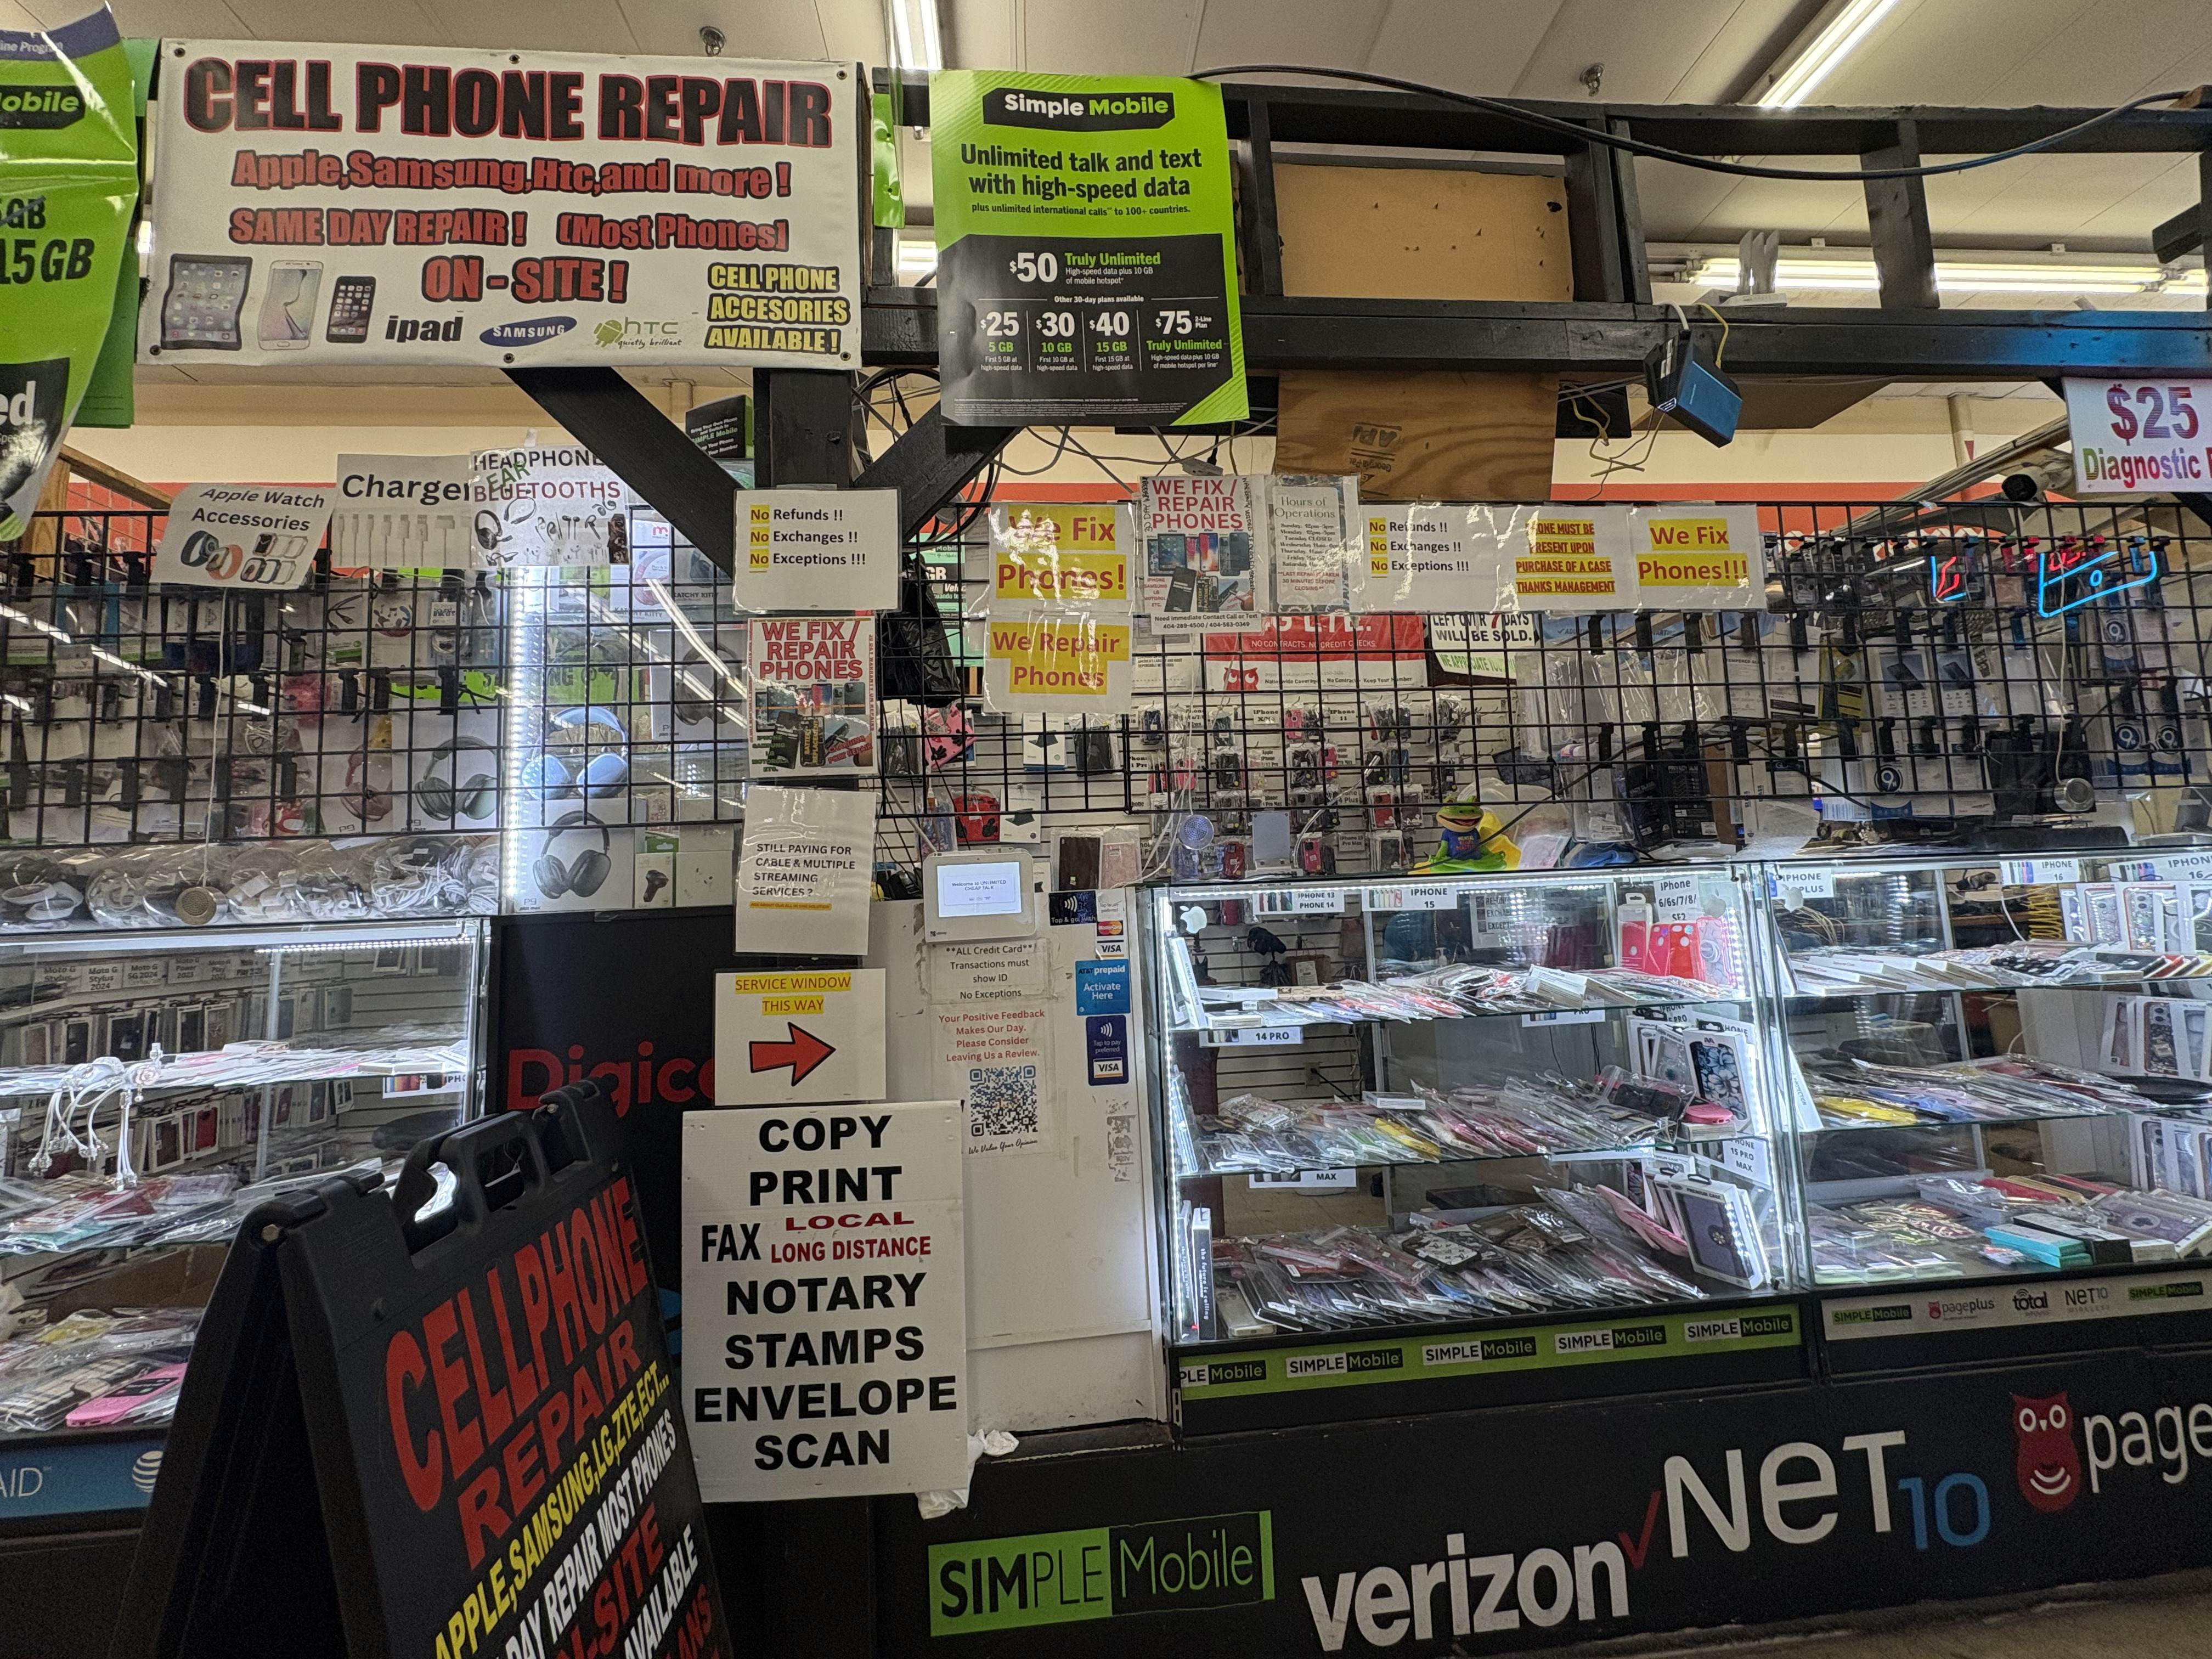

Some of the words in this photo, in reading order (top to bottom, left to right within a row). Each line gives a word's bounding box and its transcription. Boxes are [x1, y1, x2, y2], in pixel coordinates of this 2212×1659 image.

[184, 57, 342, 133] CELL
[356, 61, 584, 142] PHONE
[598, 74, 832, 148] REPAIR
[1005, 94, 1085, 119] Simple
[1089, 97, 1169, 115] Mobile
[961, 143, 1063, 171] Unlimited
[1069, 152, 1111, 172] talk
[1116, 150, 1153, 172] and
[1159, 148, 1202, 168] text
[968, 174, 1015, 196] with
[1023, 176, 1137, 203] high-speed
[1143, 177, 1190, 197] data
[972, 203, 989, 214] plus
[991, 204, 1031, 214] unlimited
[1033, 204, 1087, 216] international
[1114, 207, 1123, 216] to
[1126, 206, 1147, 216] 100+
[1149, 205, 1191, 214] countries.
[1009, 252, 1058, 283] $50
[1065, 252, 1096, 268] Truly
[1100, 252, 1161, 265] Unlimited
[708, 263, 763, 290] CELL
[764, 266, 839, 292] PHONE
[1065, 267, 1101, 275] High-speed
[707, 295, 850, 324] ACCESORIES
[385, 314, 463, 343] ipad
[493, 324, 566, 338] SAMSUNG
[980, 312, 1019, 336] $25
[1155, 311, 1192, 335] $75
[617, 336, 646, 349] quietly
[649, 336, 681, 348] brilliant
[704, 327, 826, 353] AVAILABLE
[2106, 383, 2200, 445] $25
[716, 427, 738, 437] Mobile
[2083, 447, 2201, 488] Diagnostic
[200, 487, 260, 507] Apple
[263, 491, 325, 509] Watch
[474, 479, 621, 504] BLUETOOTHS
[1282, 496, 1312, 506] Hours
[1315, 496, 1327, 506] of
[191, 507, 311, 532] Accessories
[751, 510, 769, 520] No
[774, 509, 829, 521] Refunds
[1275, 507, 1335, 519] Operations
[751, 532, 769, 542] No
[774, 531, 844, 545] Exchanges
[1650, 526, 1691, 546] We
[1696, 526, 1729, 545] Fix
[750, 554, 769, 565] No
[773, 553, 847, 566] Exceptions
[1638, 560, 1749, 584] Phones!!!
[1516, 581, 1551, 593] THANKS
[1554, 580, 1615, 593] MANAGEMENT
[762, 622, 800, 641] WE
[807, 622, 845, 640] FIX
[1437, 630, 1467, 642] WILL
[1471, 630, 1489, 641] BE
[1492, 630, 1533, 642] SOLD.
[768, 641, 856, 660] REPAIR
[760, 659, 863, 680] PHONES
[757, 843, 787, 853] STILL
[788, 844, 827, 854] PAYING
[831, 845, 851, 855] FOR
[755, 858, 791, 867] CABLE
[793, 859, 801, 867] &
[803, 860, 855, 870] MULTIPLE
[2041, 859, 2073, 870] IPHONE
[754, 872, 818, 883] STREAMING
[1660, 879, 1691, 890] IPhone
[2053, 873, 2064, 882] 16
[1410, 887, 1448, 896] IPHONE
[1424, 901, 1435, 909] 15
[974, 945, 1001, 955] Credit
[1101, 945, 1121, 953] VISA
[950, 960, 1005, 970] Transactions
[1008, 959, 1029, 968] must
[1094, 966, 1125, 975] prepaid
[735, 978, 787, 991] SERVICE
[791, 977, 851, 989] WINDOW
[973, 974, 996, 983] show
[998, 974, 1008, 982] ID
[960, 991, 972, 1000] No
[975, 989, 1022, 1001] Exceptions
[1084, 983, 1121, 992] Activate
[1092, 992, 1113, 1000] Here
[762, 1000, 791, 1012] THIS
[794, 999, 824, 1011] WAY
[939, 1014, 960, 1023] Your
[963, 1012, 999, 1022] Positive
[1001, 1009, 1045, 1020] Feedback
[956, 1026, 985, 1035] Makes
[987, 1025, 1005, 1034] Our
[1006, 1024, 1026, 1034] Day.
[1255, 1032, 1268, 1041] 14
[1269, 1031, 1290, 1041] PRO
[759, 1115, 893, 1153] COPY
[969, 1147, 979, 1155] We
[1000, 1142, 1014, 1150] Your
[1016, 1139, 1038, 1148] Opinion
[750, 1166, 902, 1206] PRINT
[786, 1211, 915, 1231] LOCAL
[702, 1223, 761, 1262] FAX
[771, 1242, 826, 1263] LONG
[833, 1236, 931, 1260] DISTANCE
[727, 1272, 927, 1316] NOTARY
[2012, 1291, 2048, 1311] total
[1942, 1298, 1995, 1314] pageplus
[725, 1326, 924, 1369] STAMPS
[1288, 1357, 1345, 1376] SIMPLE
[1348, 1350, 1402, 1369] Mobile
[695, 1375, 957, 1423] ENVELOPE
[456, 1318, 642, 1571] REPAIR
[754, 1429, 890, 1471] SCAN
[939, 1545, 1104, 1618] SIMPLE
[1119, 1528, 1254, 1599] Mobile
[1300, 1532, 1632, 1652] verizon
